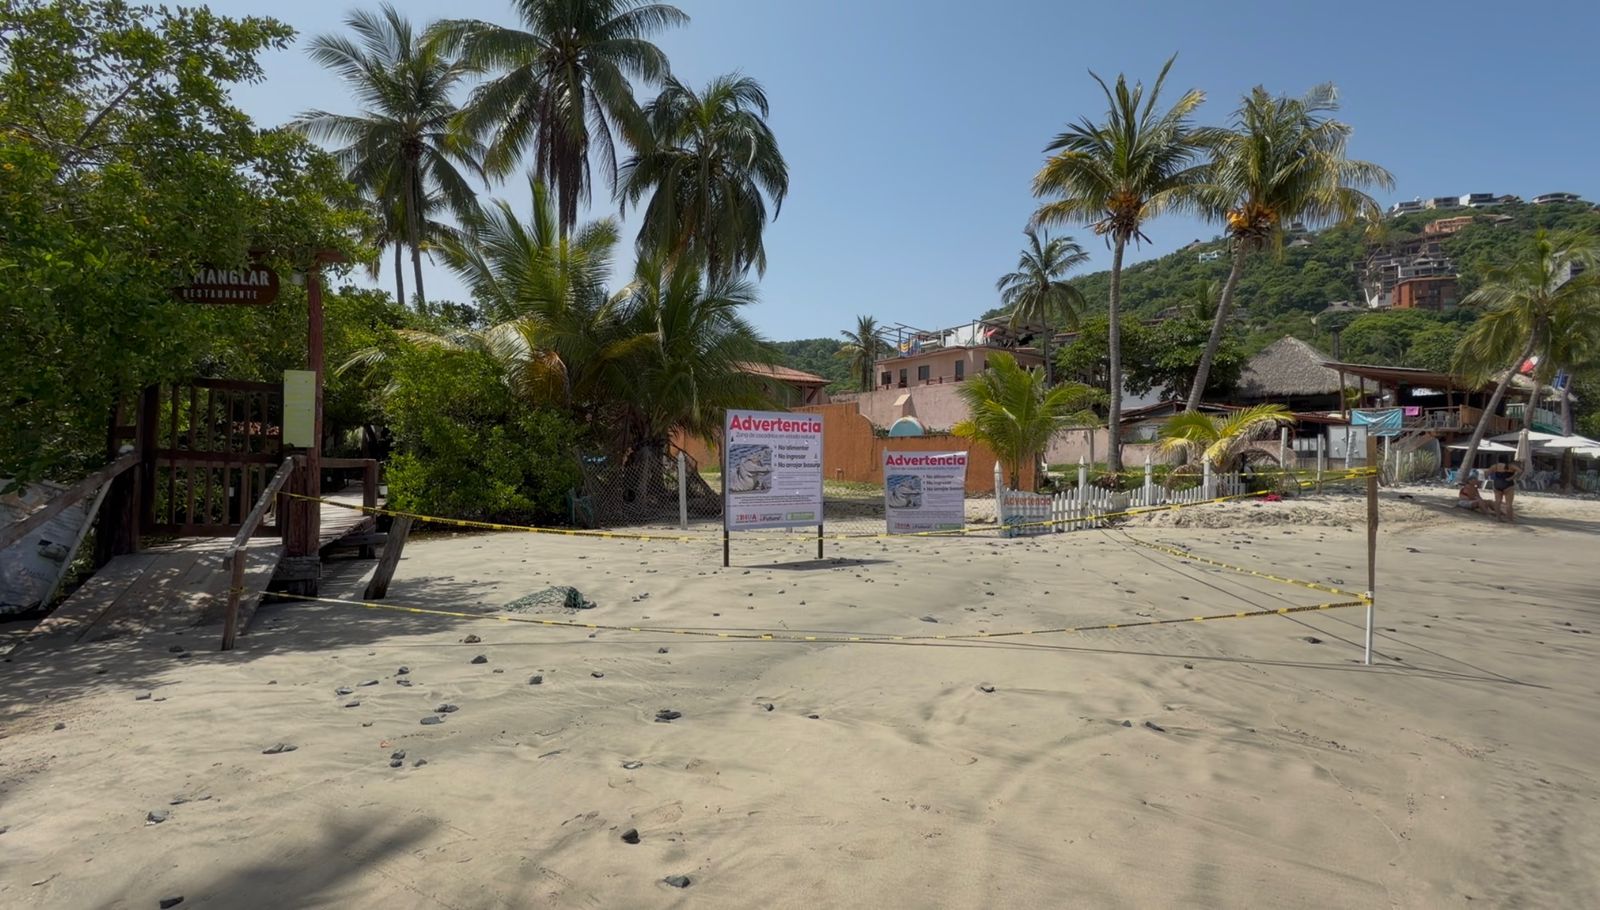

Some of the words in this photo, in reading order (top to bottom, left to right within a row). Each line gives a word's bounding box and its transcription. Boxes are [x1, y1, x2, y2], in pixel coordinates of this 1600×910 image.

[194, 269, 270, 286] MANGLAR
[183, 289, 257, 299] RESTAURANTE
[730, 415, 821, 432] Advertencia
[886, 454, 965, 466] Advertencia
